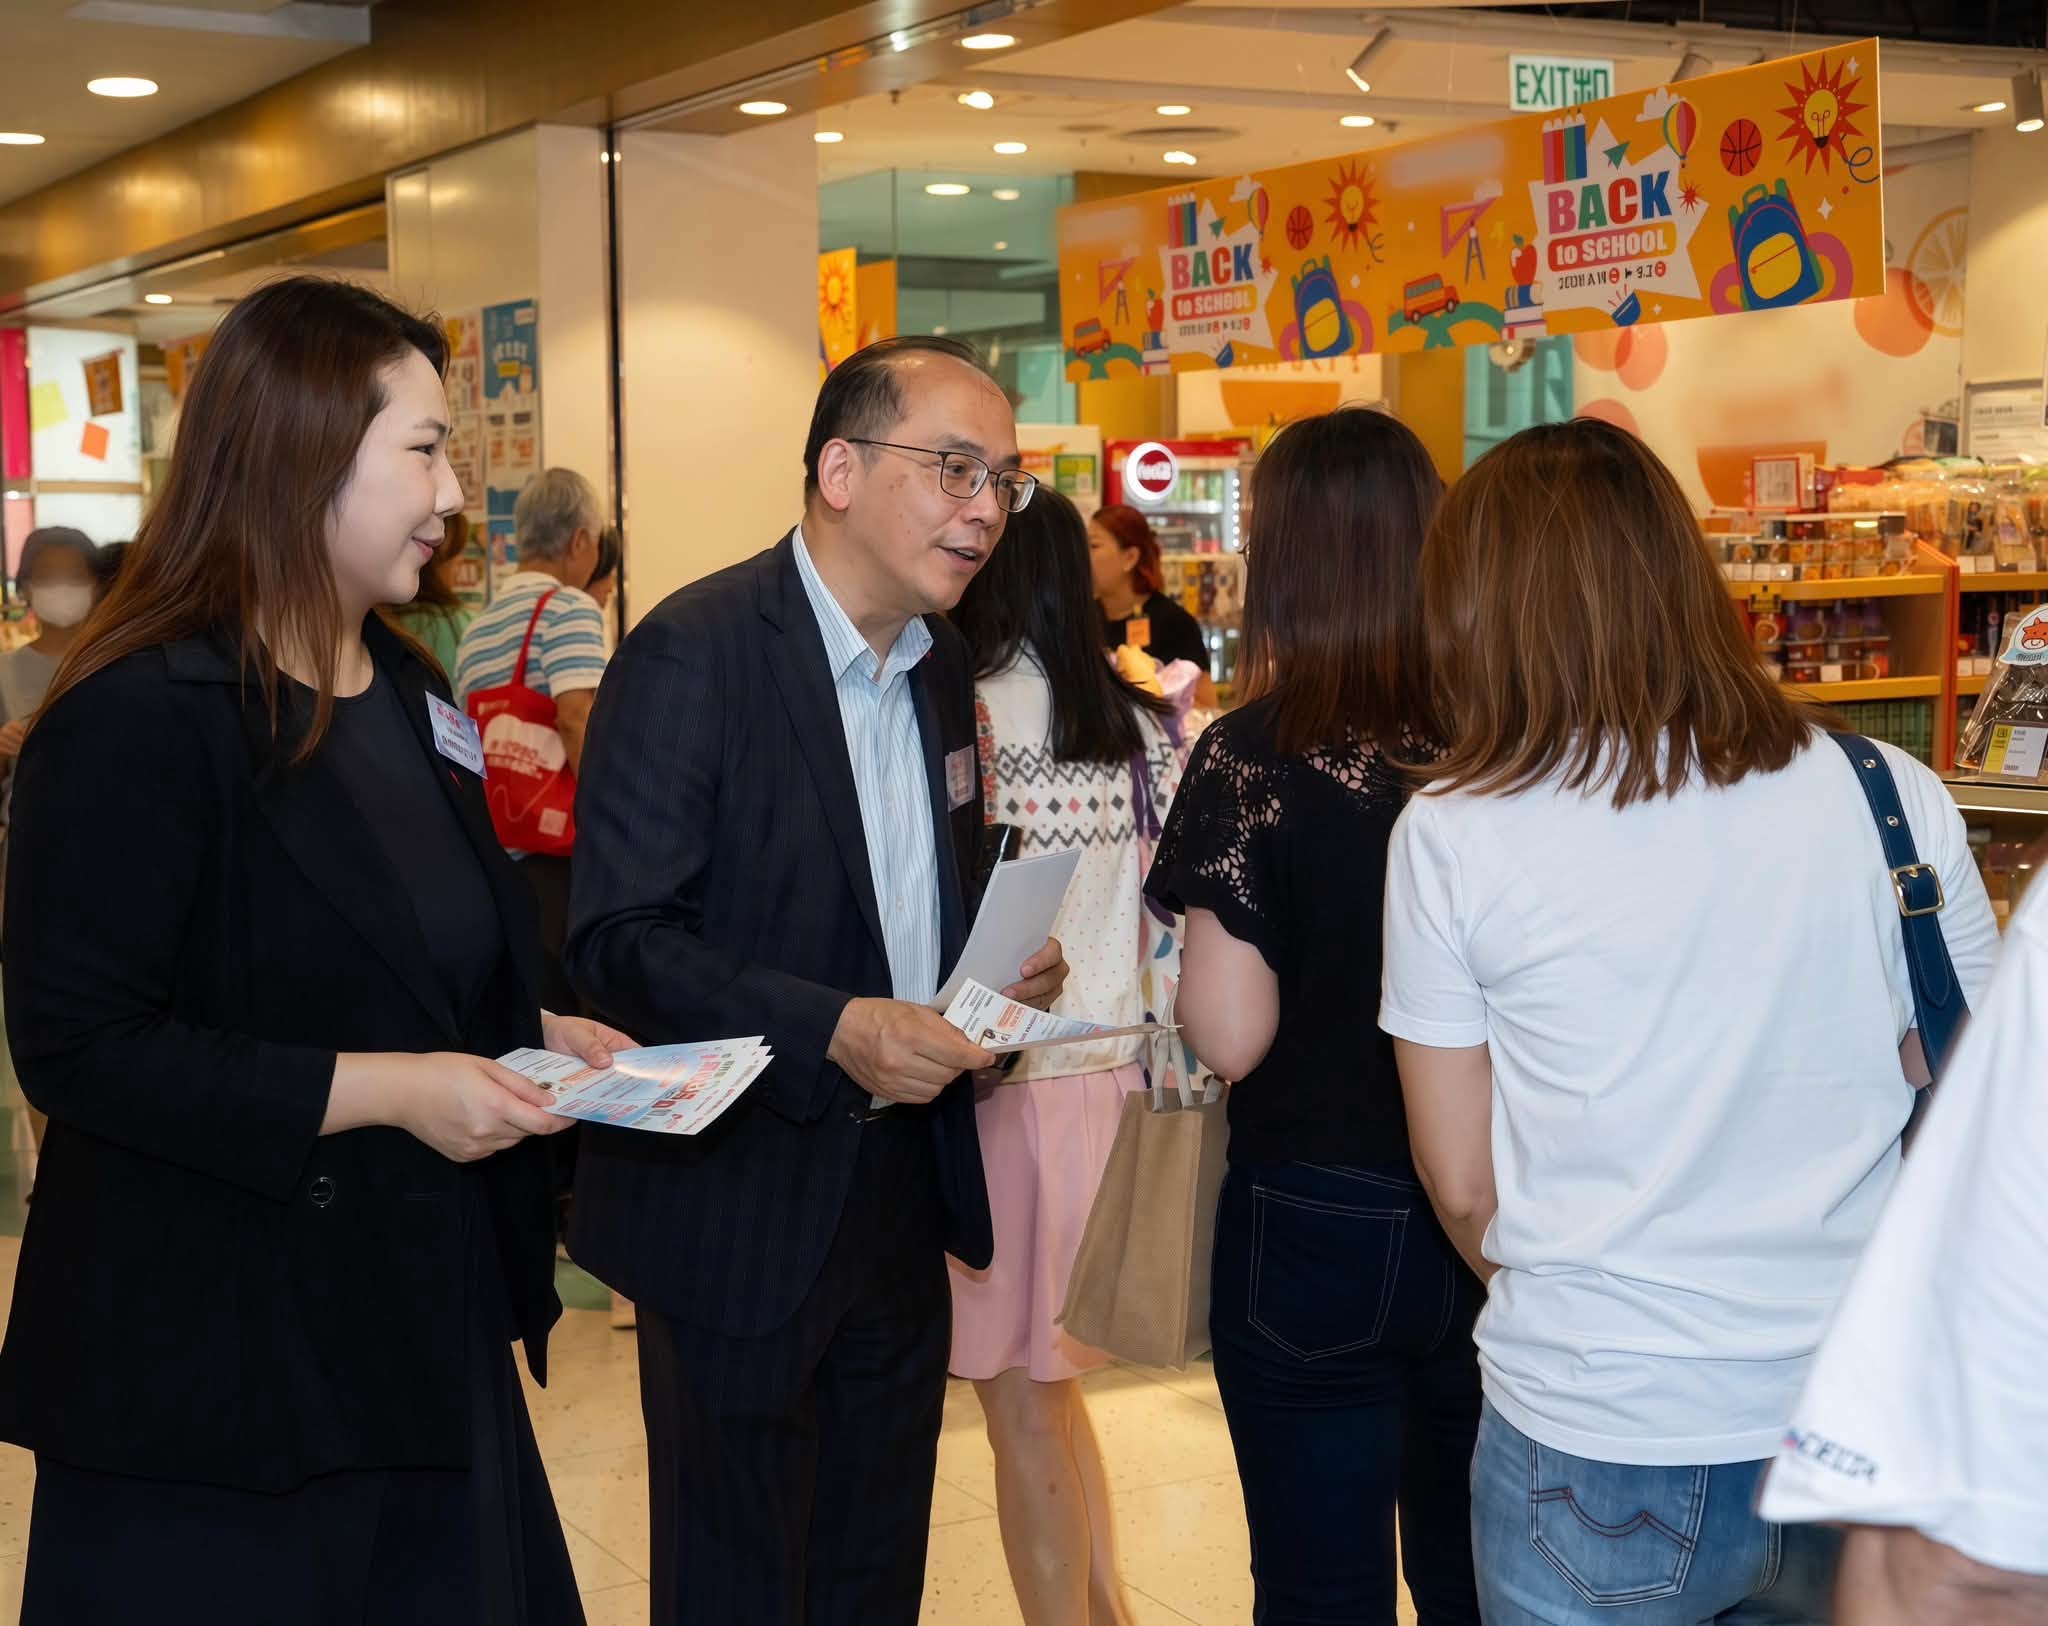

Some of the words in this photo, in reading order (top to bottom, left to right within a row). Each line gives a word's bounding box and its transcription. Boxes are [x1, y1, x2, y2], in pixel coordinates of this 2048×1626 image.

[1516, 64, 1570, 107] EXIT
[1548, 171, 1672, 235] BACK
[1582, 229, 1667, 262] SCHOOL
[1171, 244, 1254, 291] BACK
[1195, 290, 1250, 314] SCHOOL
